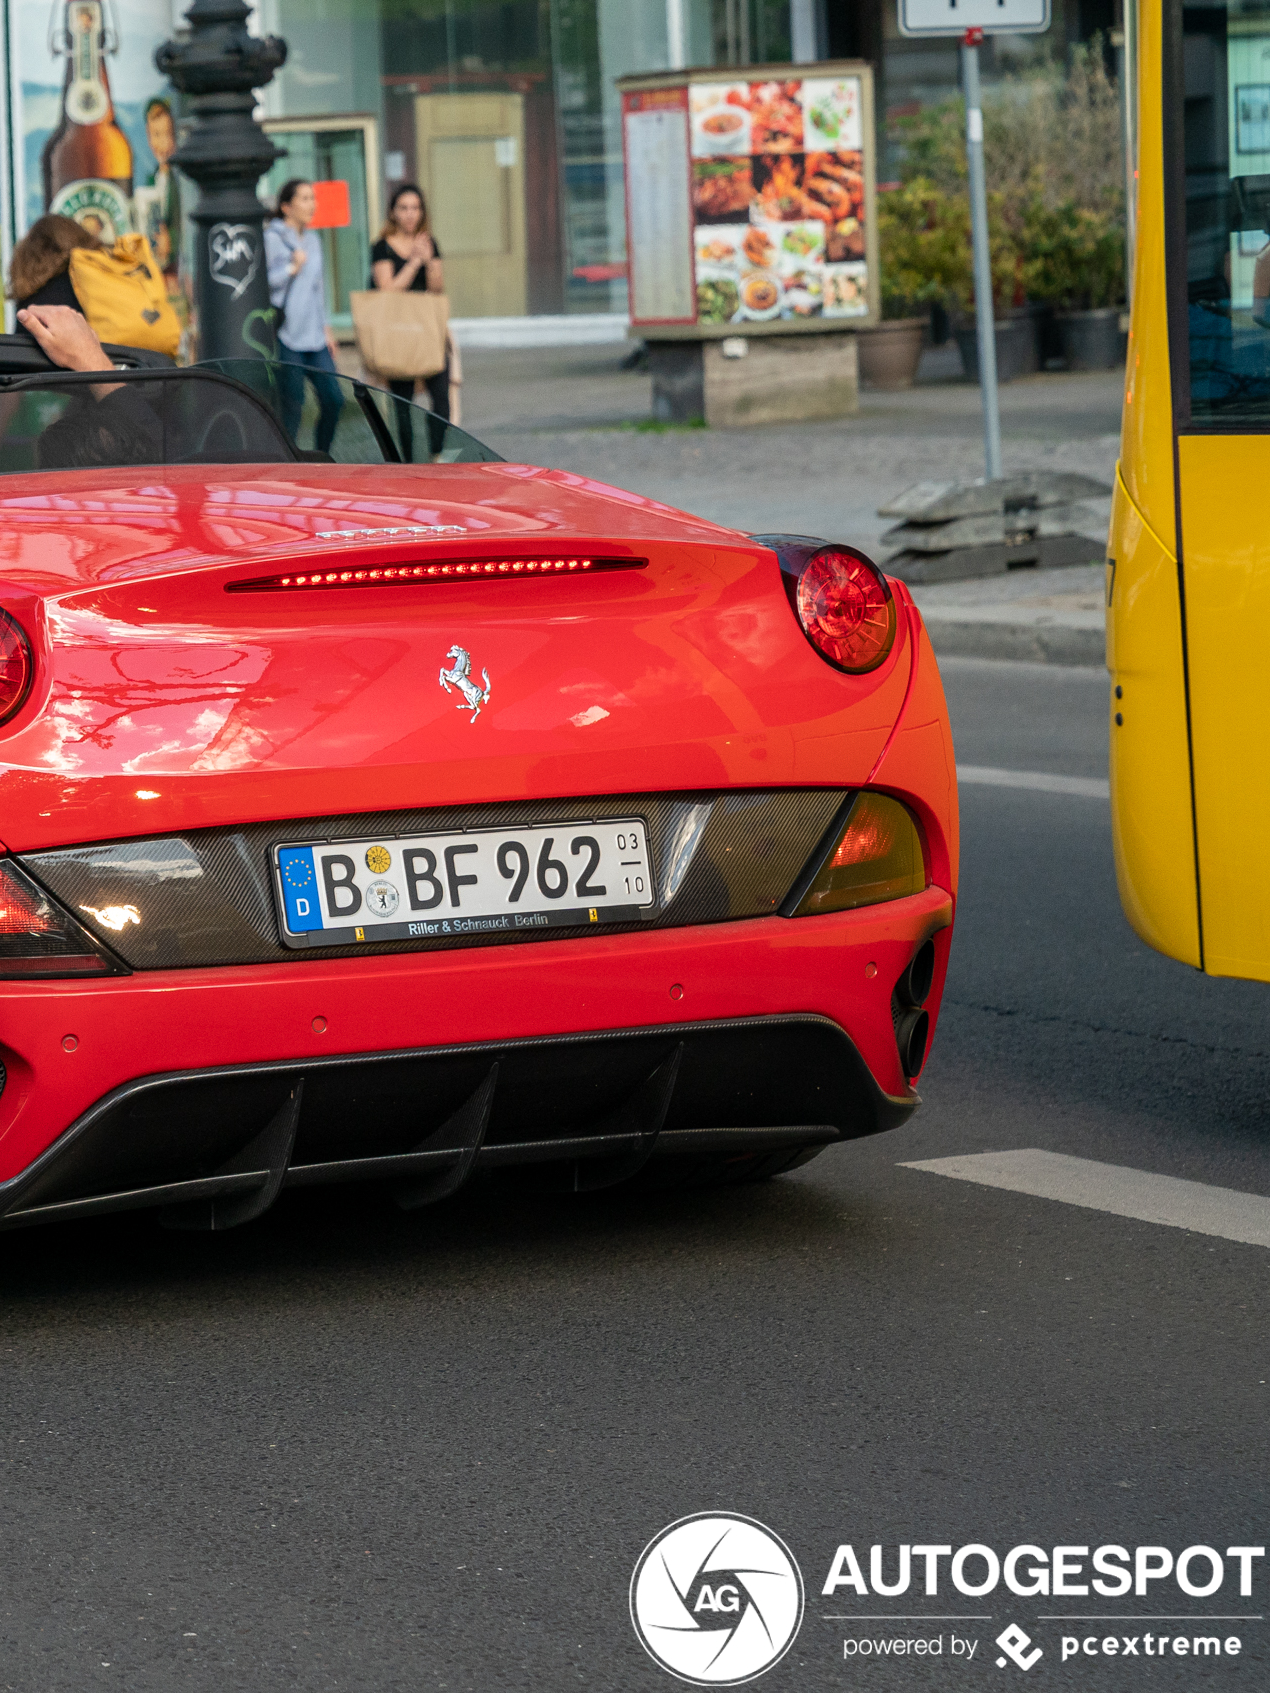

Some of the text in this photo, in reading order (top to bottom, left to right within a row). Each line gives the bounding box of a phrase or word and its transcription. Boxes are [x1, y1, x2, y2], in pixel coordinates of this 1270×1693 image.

[616, 833, 638, 850] 03
[321, 836, 607, 917] B BF 962
[624, 876, 644, 894] 10
[295, 898, 310, 916] D
[408, 913, 549, 936] Riller & Schnauck Berlin
